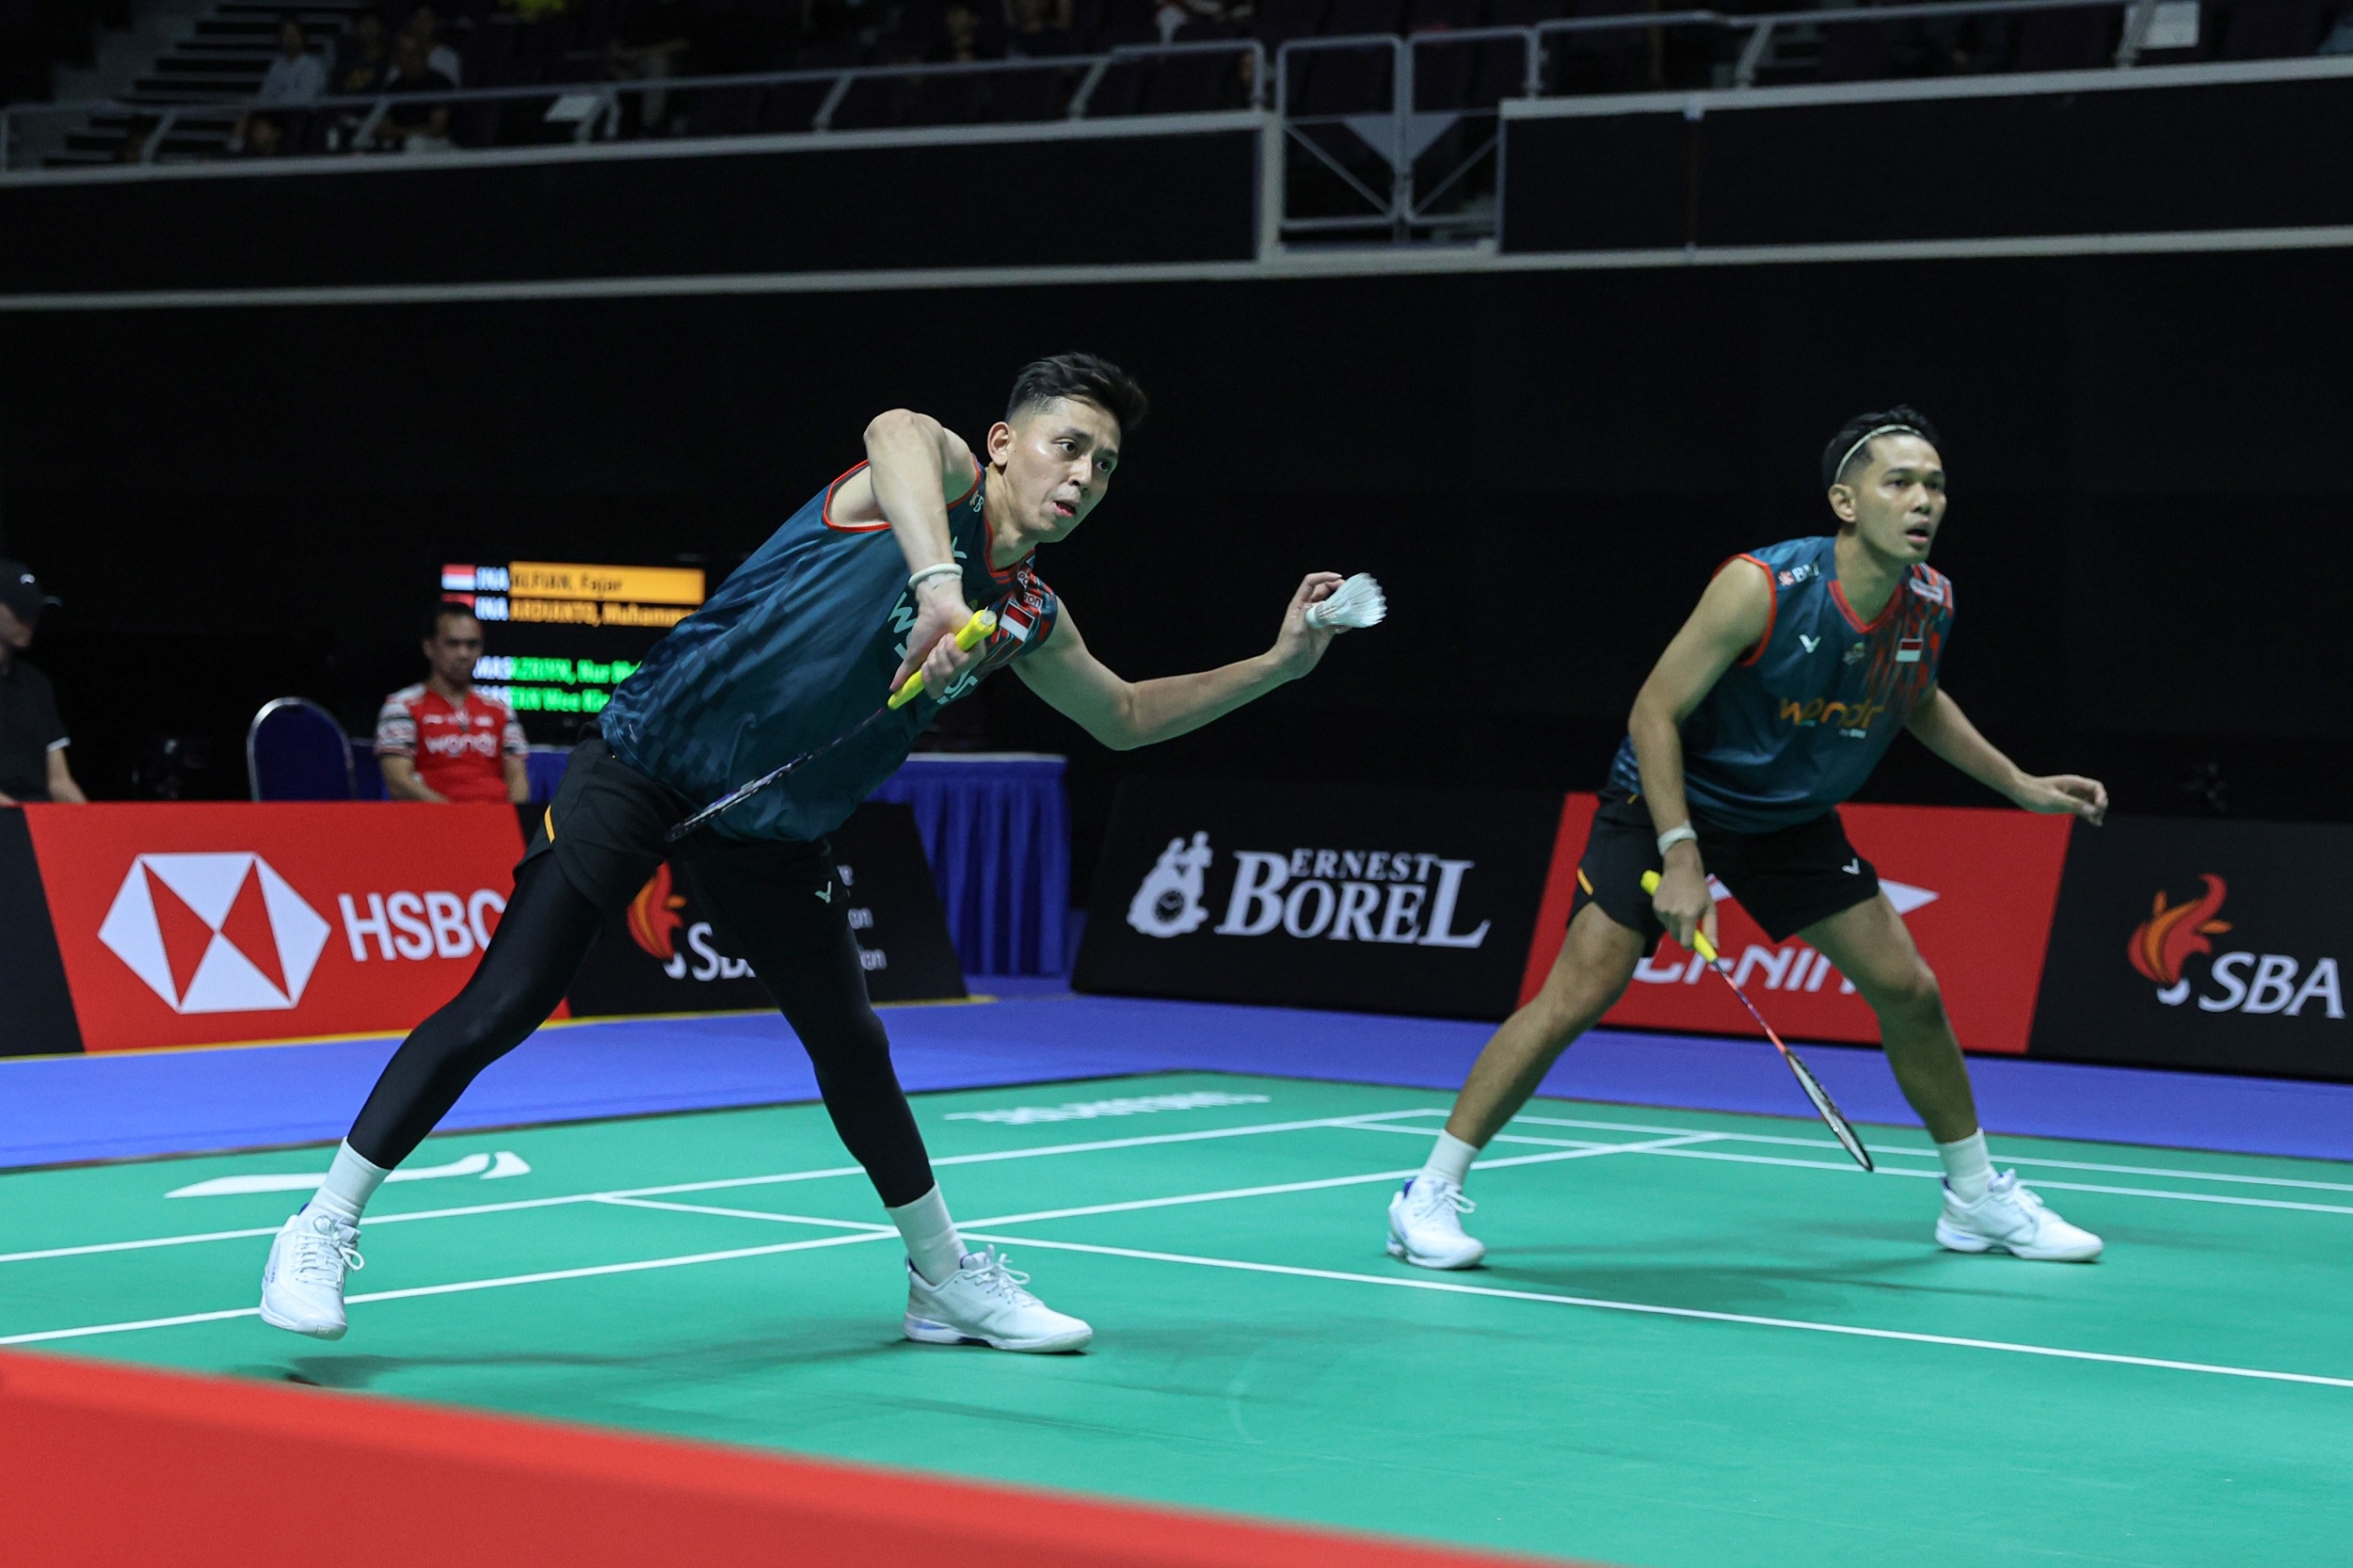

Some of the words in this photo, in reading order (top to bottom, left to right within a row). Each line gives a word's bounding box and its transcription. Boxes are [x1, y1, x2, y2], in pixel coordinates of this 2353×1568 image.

[1213, 850, 1492, 949] BOREL
[1289, 848, 1437, 883] ERNEST
[337, 888, 506, 962] HSBC
[2198, 951, 2346, 1018] SBA
